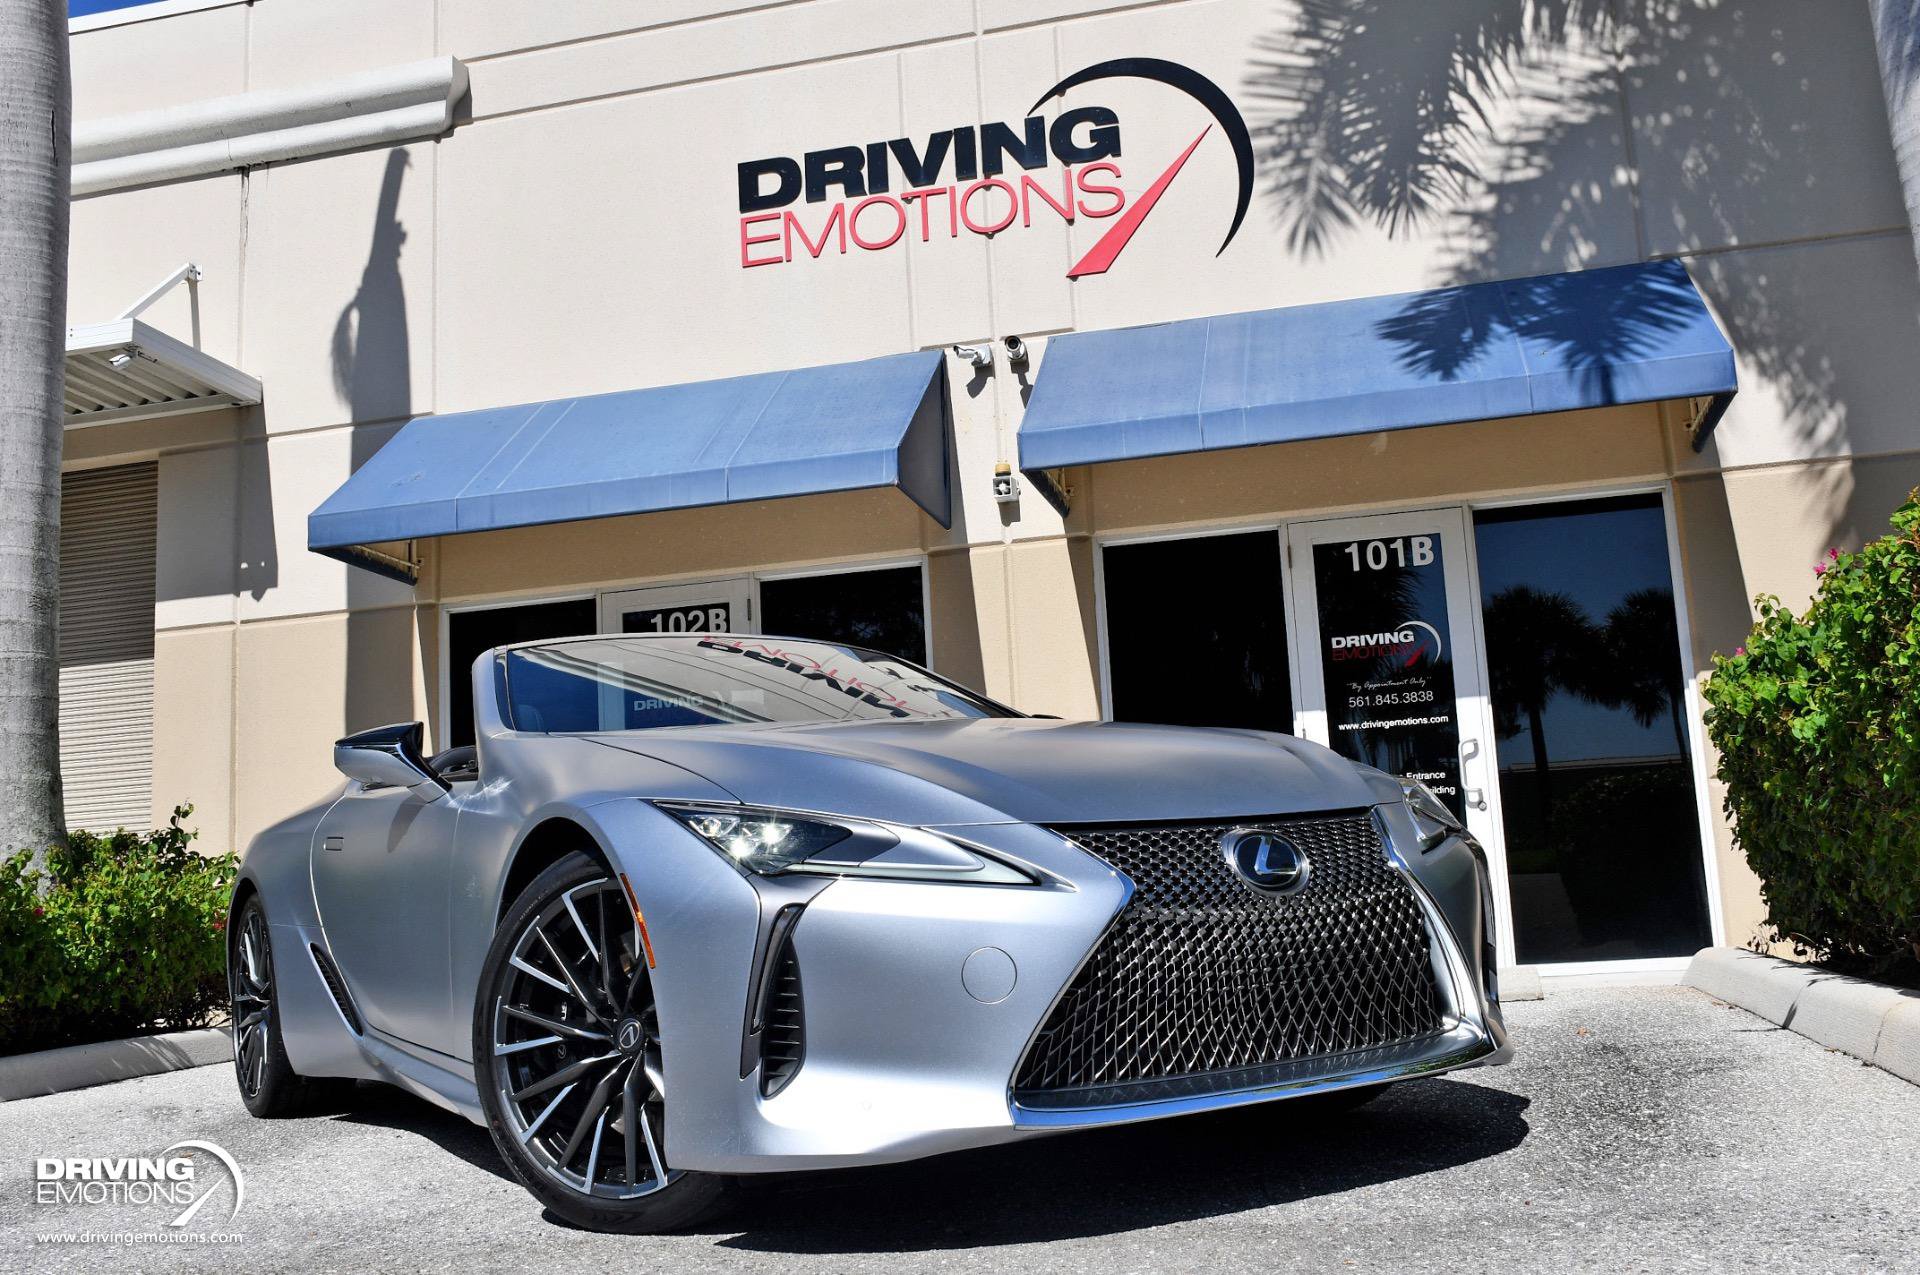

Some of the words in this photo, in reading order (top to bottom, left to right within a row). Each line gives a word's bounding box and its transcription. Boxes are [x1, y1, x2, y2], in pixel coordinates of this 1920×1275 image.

[737, 106, 1122, 214] DRIVING
[740, 162, 1125, 268] EMOTIONS
[1344, 536, 1434, 572] 101B
[650, 608, 727, 633] 102B
[1331, 630, 1415, 649] DRIVING
[1348, 690, 1434, 708] 561.845.3838
[1338, 715, 1449, 730] www.drivingemotions.com
[1406, 771, 1446, 780] Entrance
[1429, 785, 1456, 796] ilding
